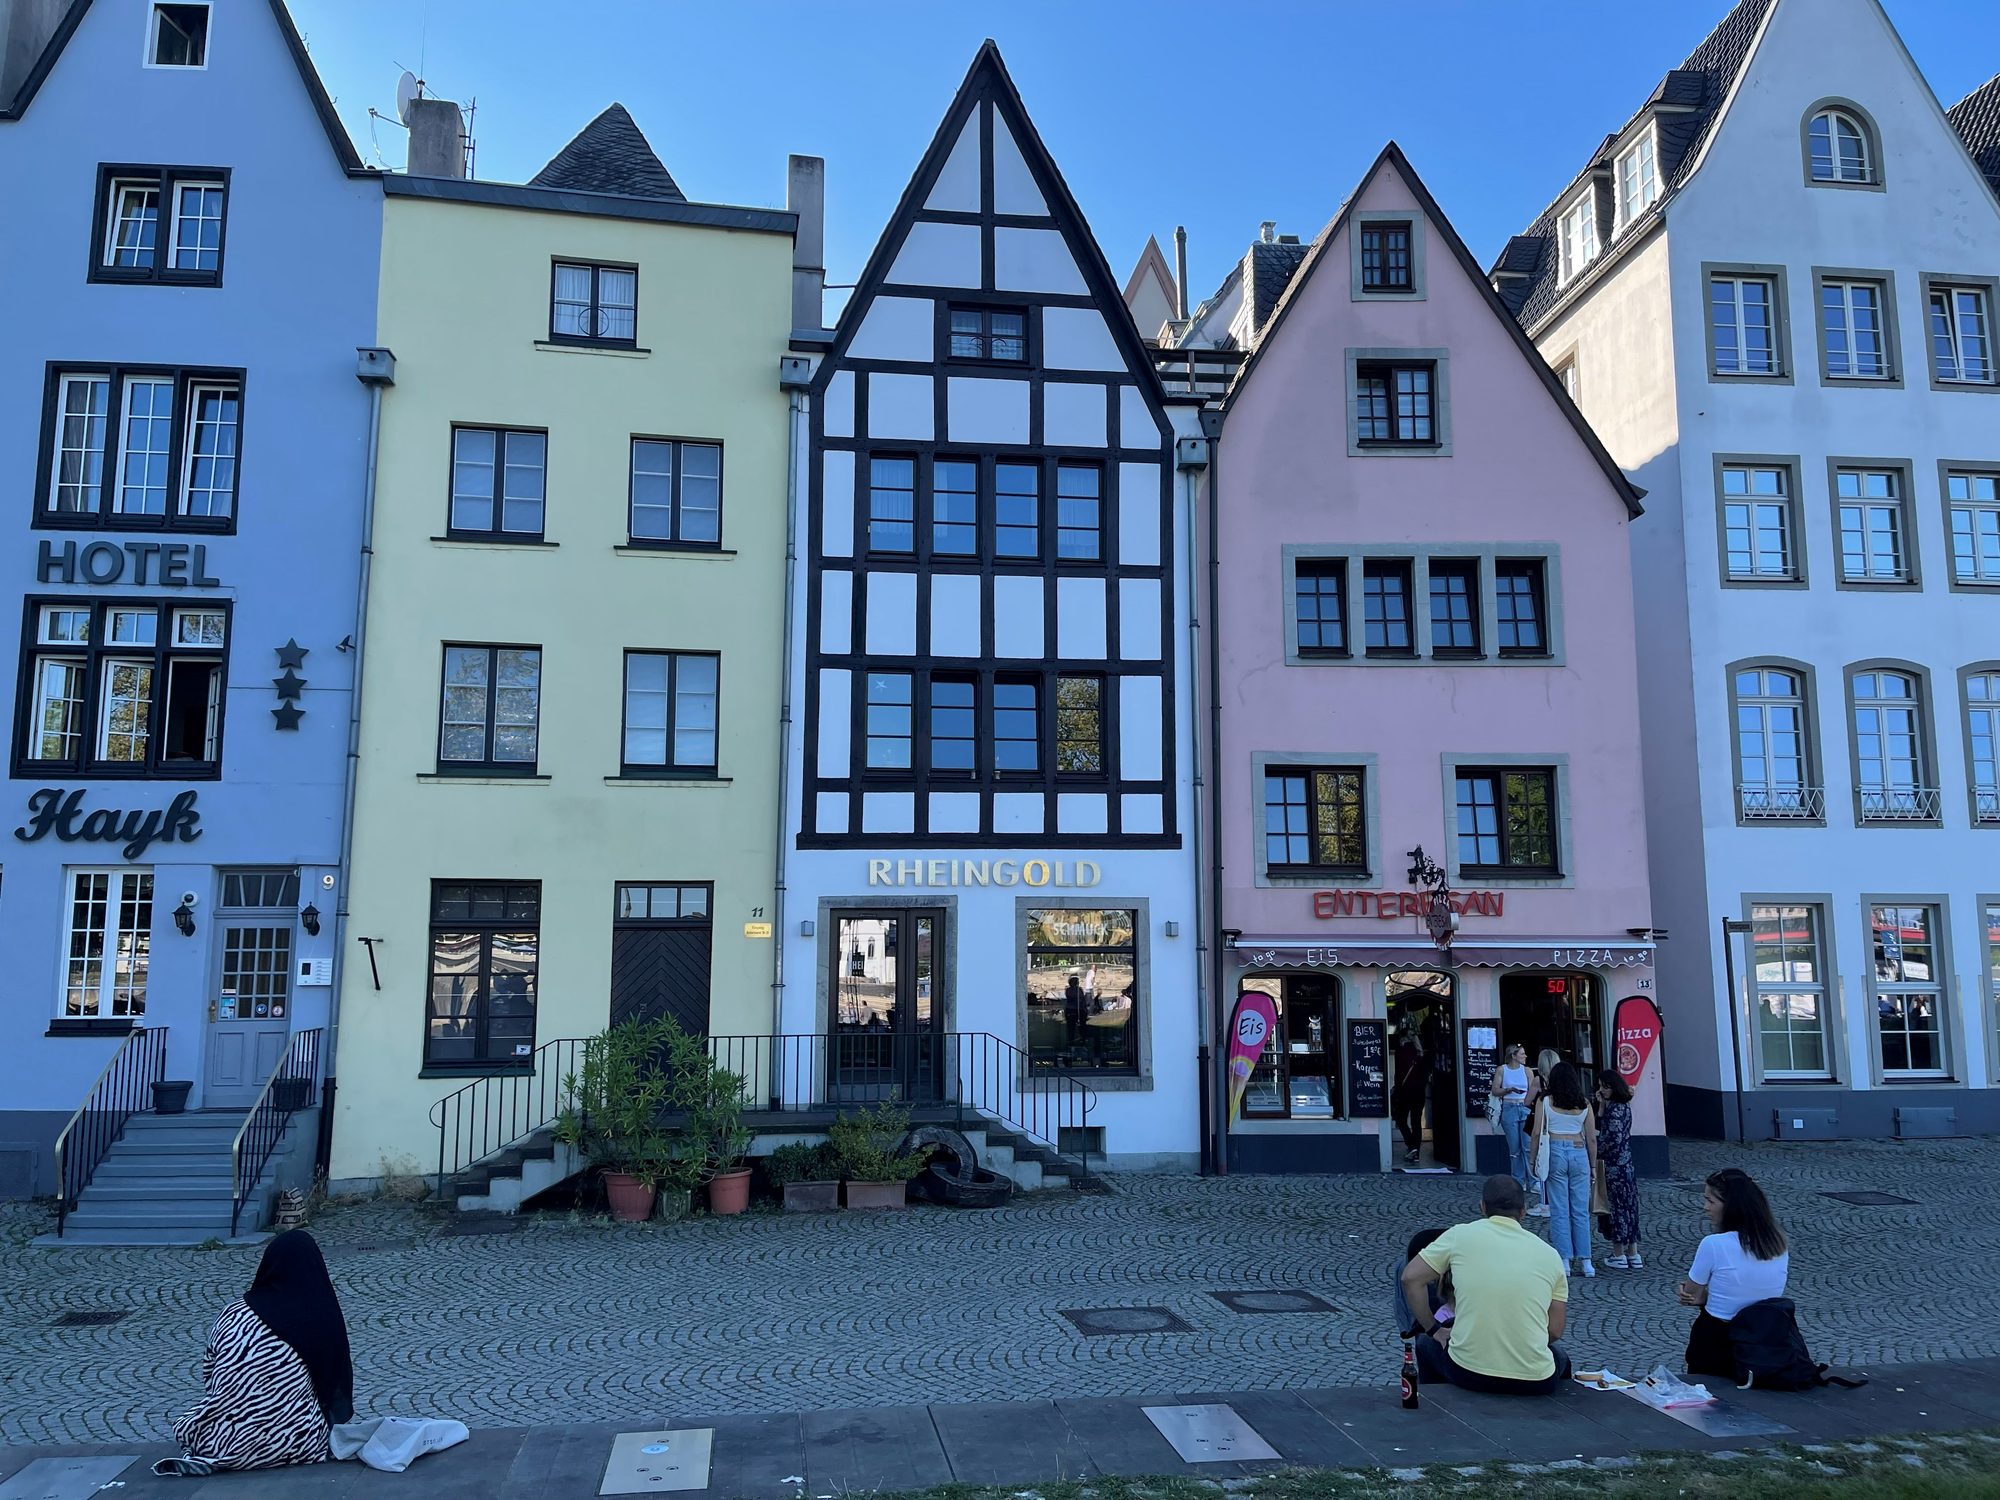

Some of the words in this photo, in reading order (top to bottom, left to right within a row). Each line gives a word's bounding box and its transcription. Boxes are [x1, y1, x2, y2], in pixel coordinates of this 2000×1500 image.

[37, 540, 220, 587] HOTEL
[14, 788, 203, 860] Hayk
[868, 859, 1101, 888] RHEINGOLD
[323, 875, 335, 890] 9
[751, 906, 764, 918] 11
[1053, 922, 1109, 936] SCHMUCK
[1252, 954, 1264, 963] to
[1265, 950, 1276, 962] go
[1553, 949, 1613, 963] PIZZA
[1623, 955, 1635, 963] to
[1637, 950, 1648, 962] go
[1547, 980, 1565, 993] 50
[1239, 1017, 1264, 1036] Eis
[1354, 1025, 1376, 1037] BIER
